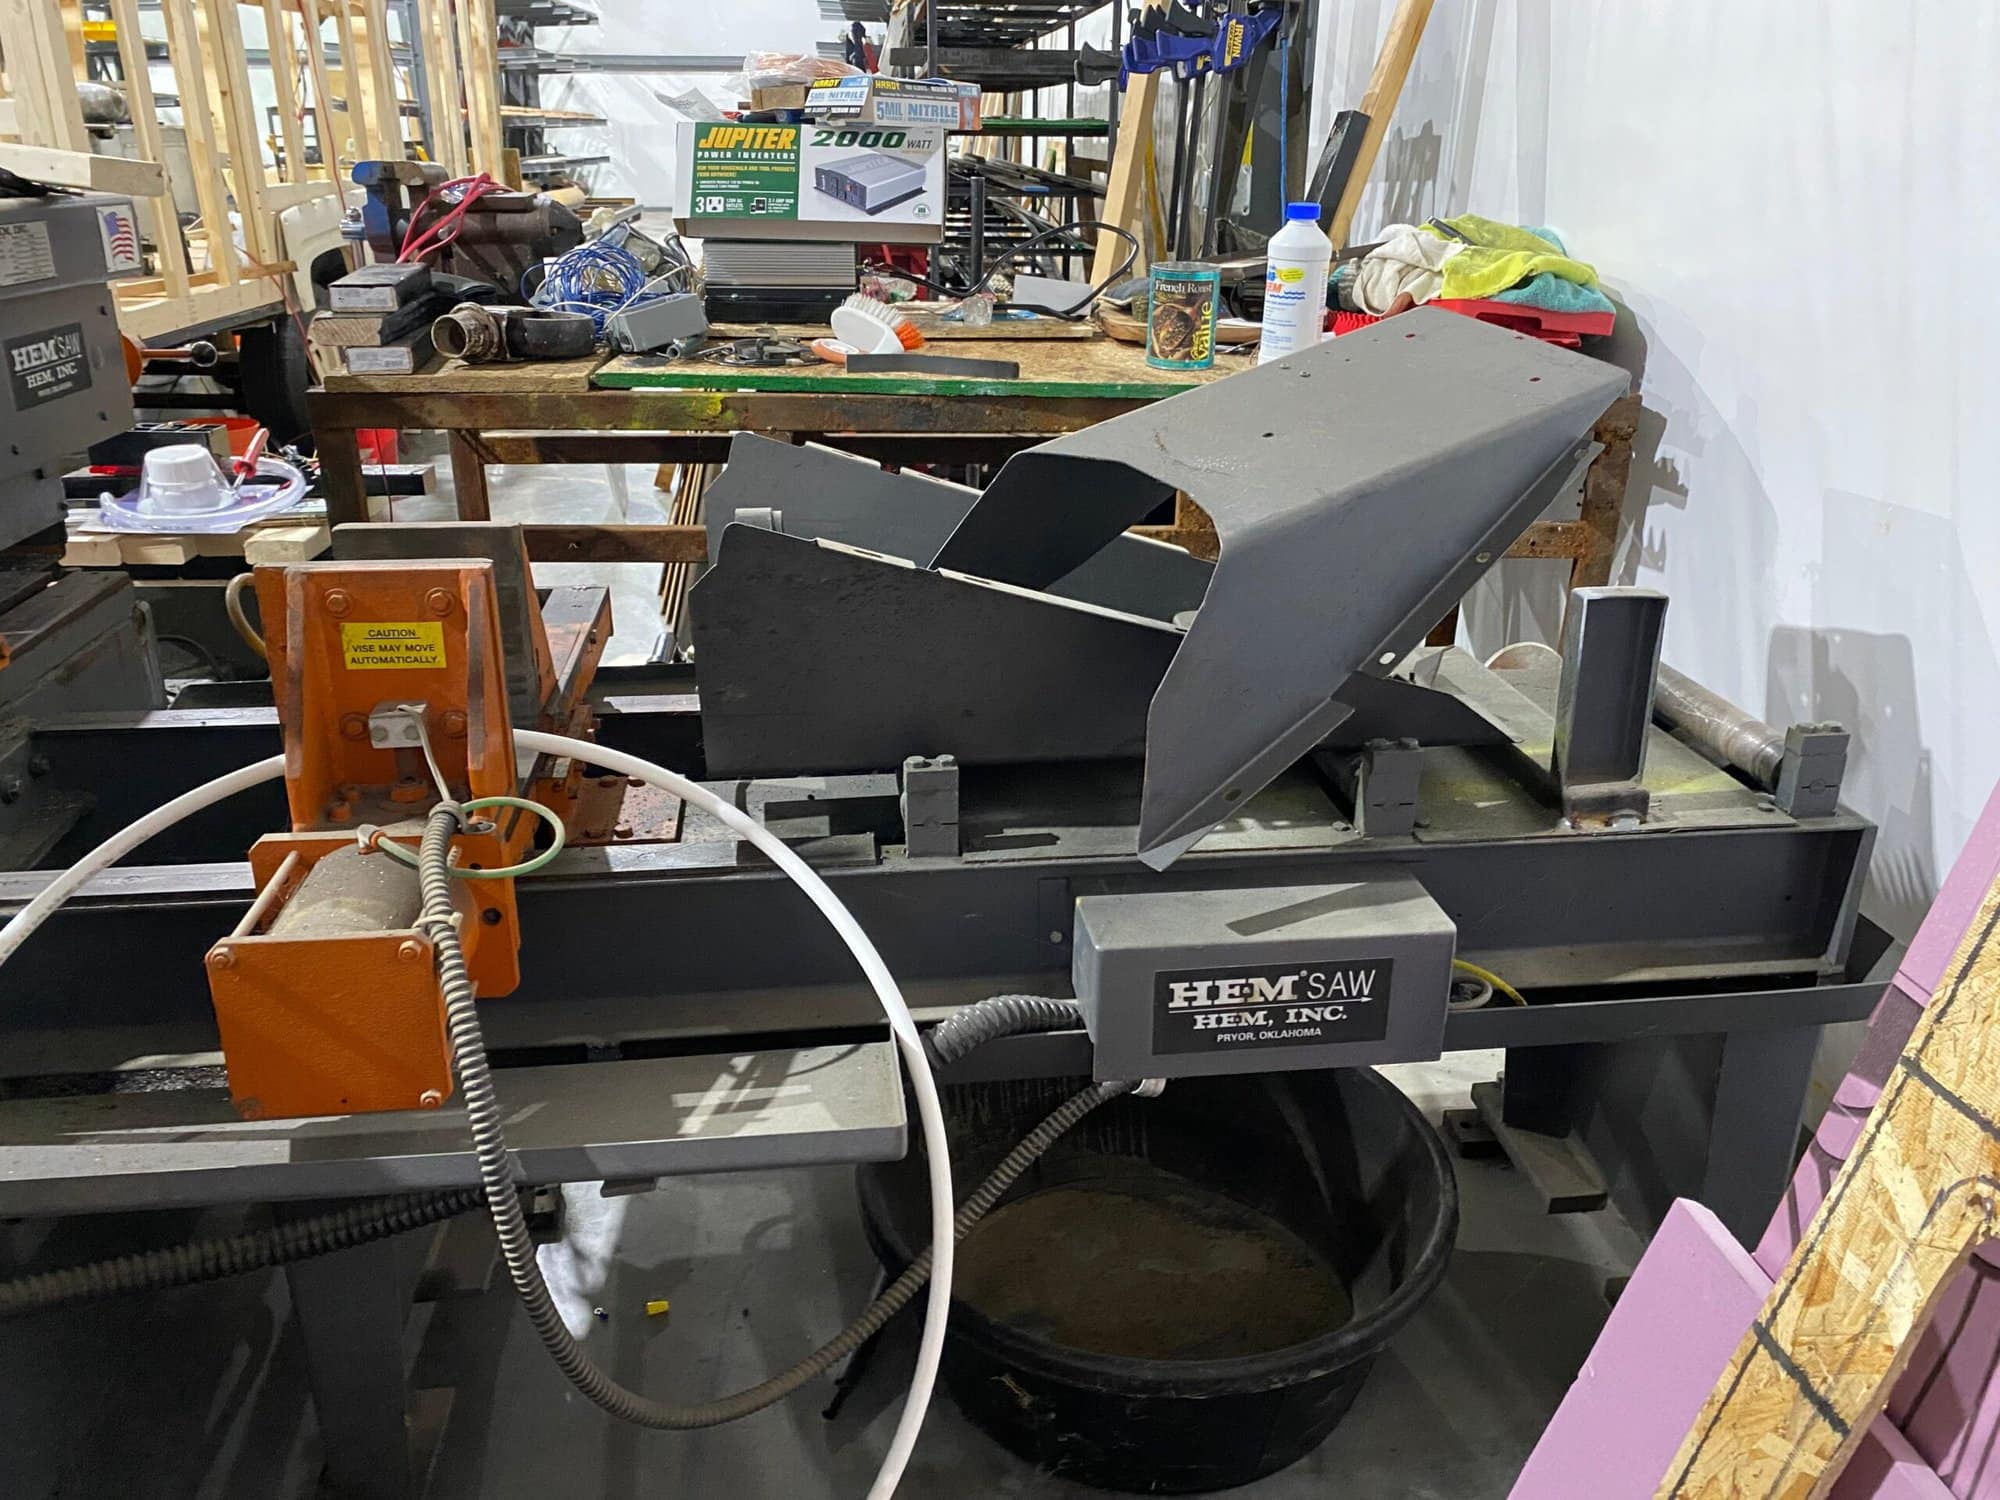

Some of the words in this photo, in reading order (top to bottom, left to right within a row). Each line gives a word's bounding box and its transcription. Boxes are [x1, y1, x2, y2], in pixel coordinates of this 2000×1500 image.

[1232, 24, 1244, 57] IRWIN
[828, 90, 865, 99] NITRILE
[908, 103, 958, 118] NITRILE
[698, 127, 796, 149] JUPITER
[810, 130, 906, 148] 2000
[907, 139, 932, 149] WATT
[738, 151, 795, 159] INVERTERS
[695, 196, 704, 213] 3
[1155, 280, 1185, 292] French
[1188, 282, 1212, 293] Roast
[1194, 301, 1213, 360] value
[57, 332, 80, 358] SAW
[368, 629, 416, 638] CAUTION
[352, 644, 375, 652] VISE
[379, 644, 400, 652] MAY
[405, 644, 435, 652] MOVE
[351, 656, 437, 664] AUTOMATICALLY
[1307, 969, 1376, 999] SAW
[1193, 1010, 1274, 1030] HEM,
[1285, 1005, 1348, 1024] INC.
[1259, 1027, 1322, 1040] OKLAHOMA
